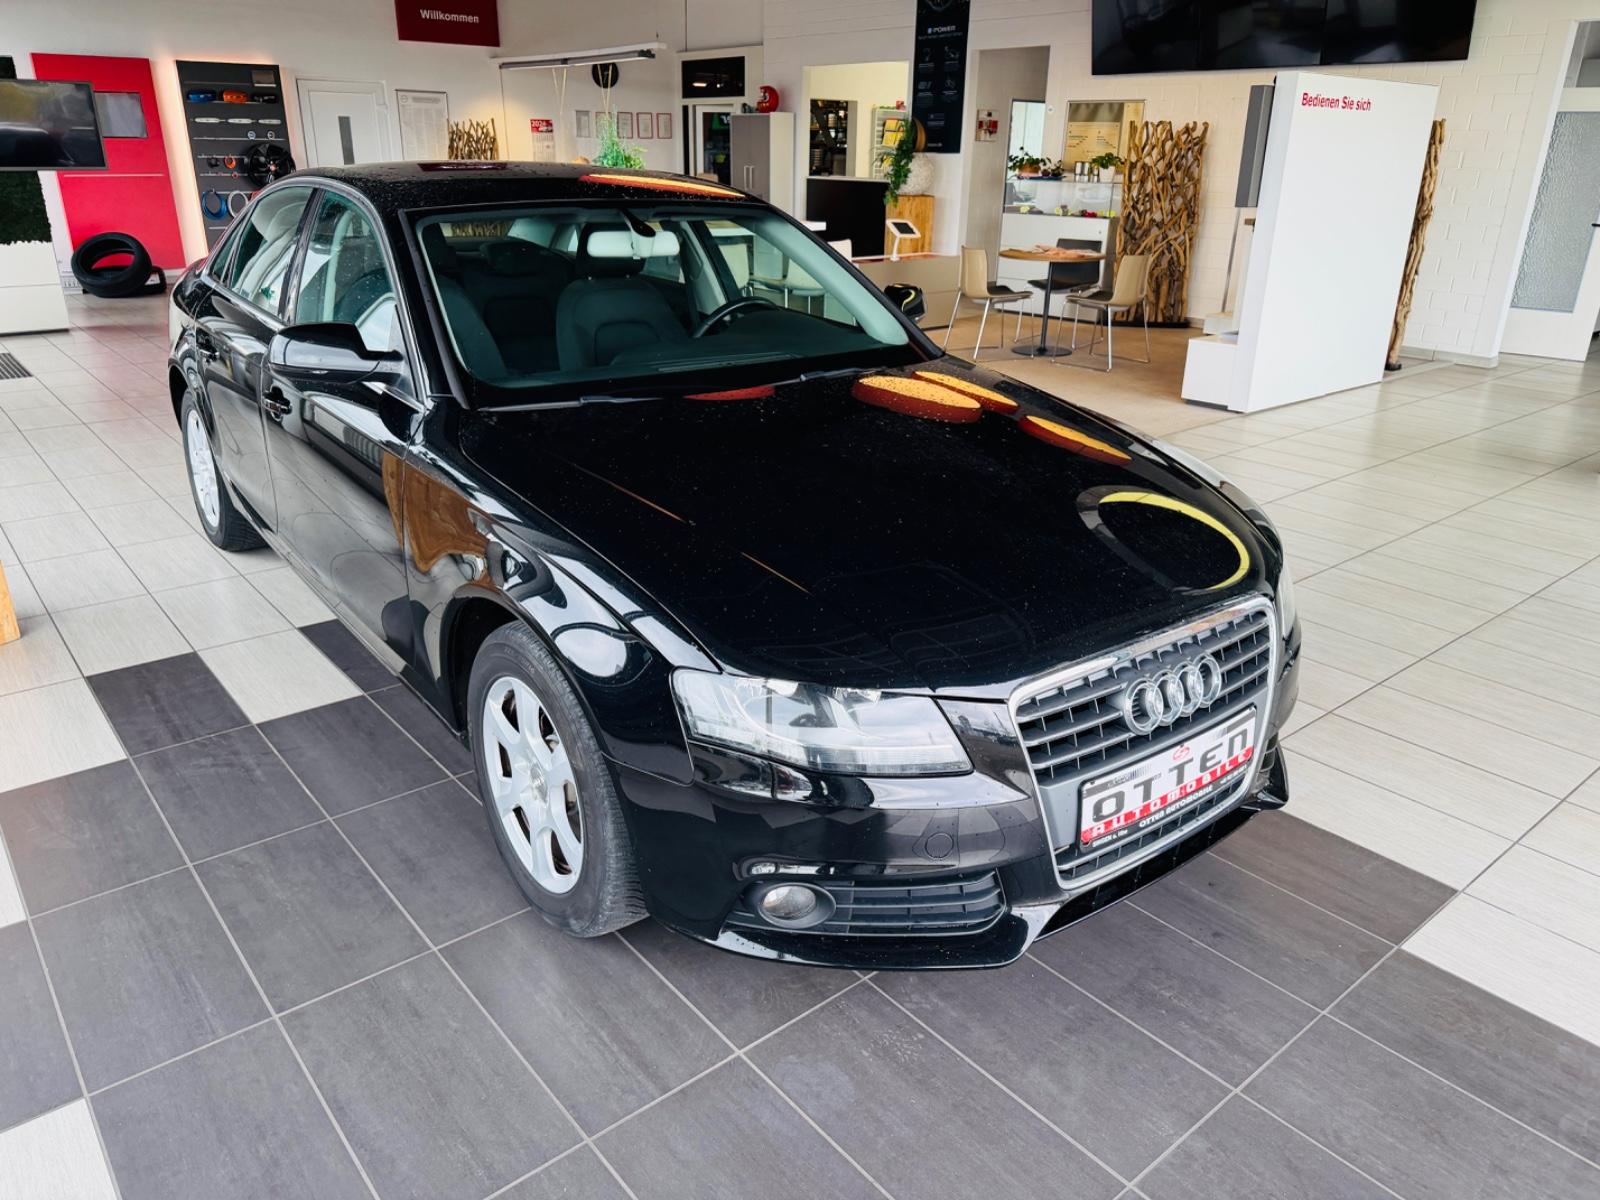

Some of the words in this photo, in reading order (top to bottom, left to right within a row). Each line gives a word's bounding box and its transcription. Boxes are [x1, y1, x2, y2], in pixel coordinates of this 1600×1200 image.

[420, 9, 479, 23] Willkommen
[1302, 92, 1340, 109] Bedienen
[1341, 95, 1354, 110] Sie
[1355, 97, 1371, 112] sich
[1092, 729, 1248, 823] OTTEN
